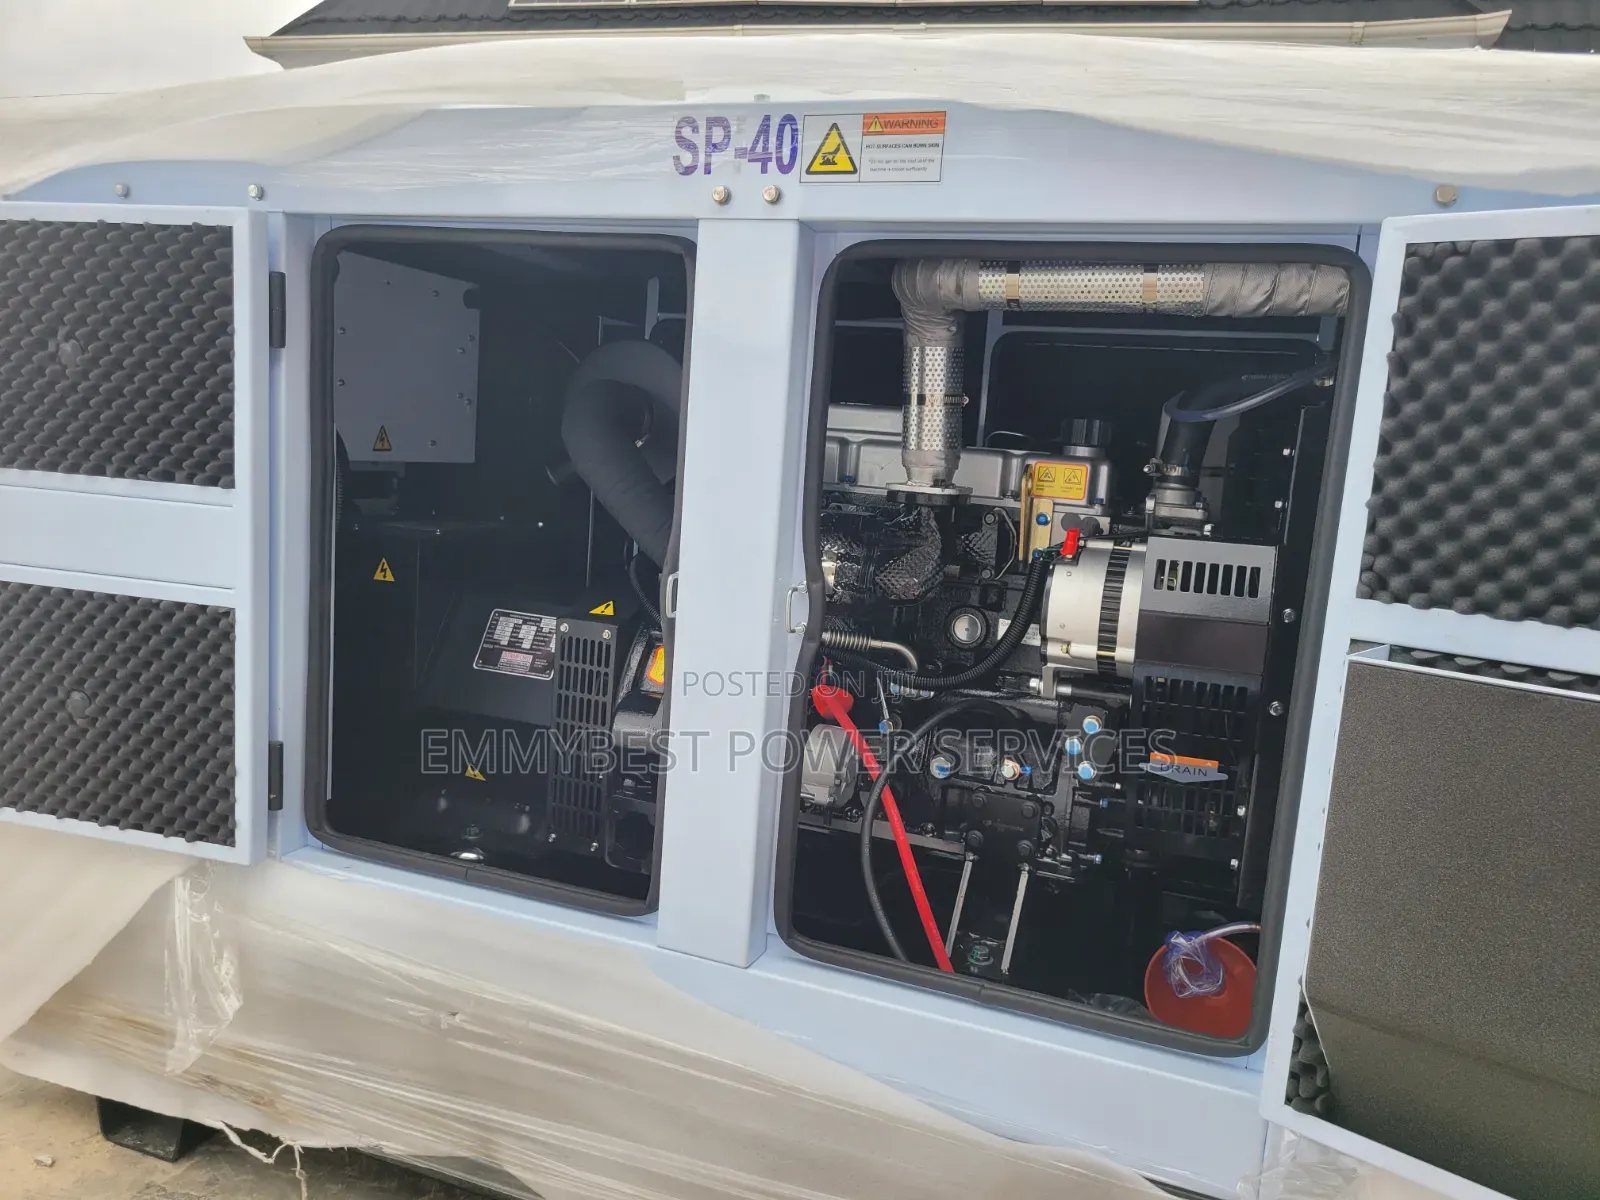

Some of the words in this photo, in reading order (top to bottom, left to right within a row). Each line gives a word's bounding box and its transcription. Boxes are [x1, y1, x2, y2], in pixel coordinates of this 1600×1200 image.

[883, 118, 939, 129] WARNING
[672, 112, 799, 176] SP-40
[1160, 763, 1208, 777] DRAIN
